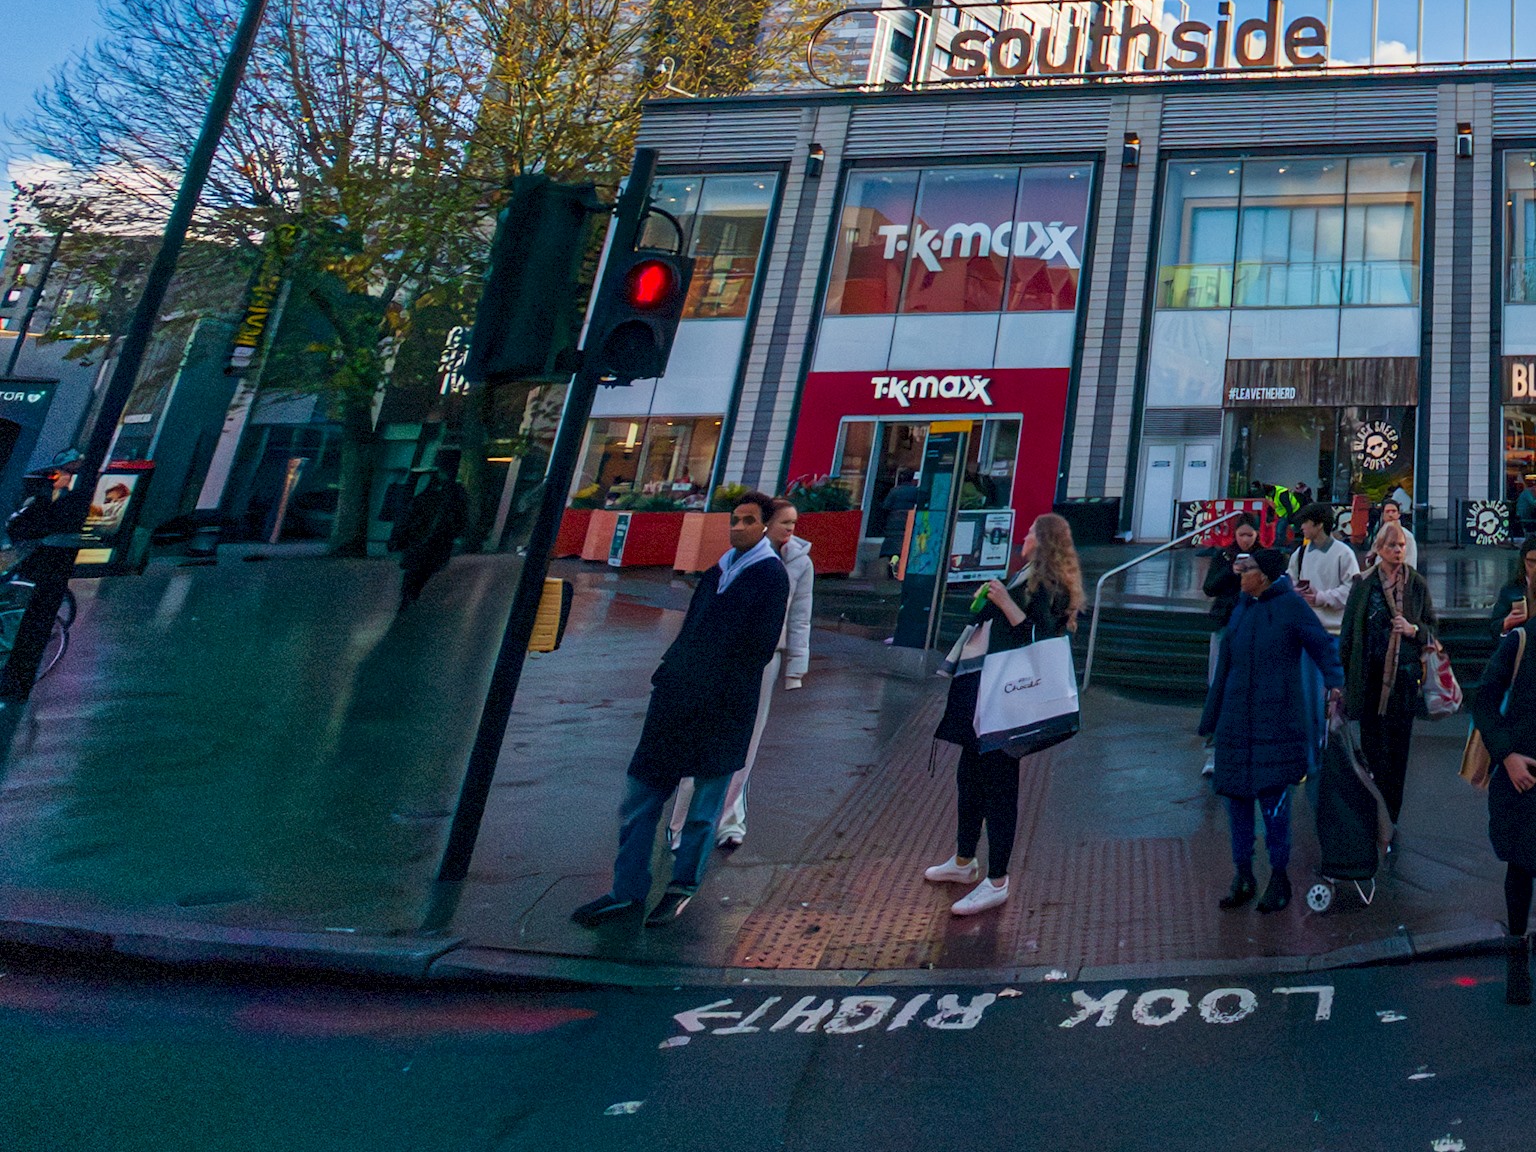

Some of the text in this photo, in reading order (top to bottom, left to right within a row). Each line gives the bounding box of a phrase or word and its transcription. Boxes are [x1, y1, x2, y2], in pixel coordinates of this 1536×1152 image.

[1228, 387, 1296, 400] #LEAVETHEHERD
[1353, 420, 1399, 451] BLACK SHEEP
[1362, 450, 1398, 470] COFFEE
[1466, 500, 1485, 528] BLACK
[710, 986, 1336, 1036] LOOK RIGHT
